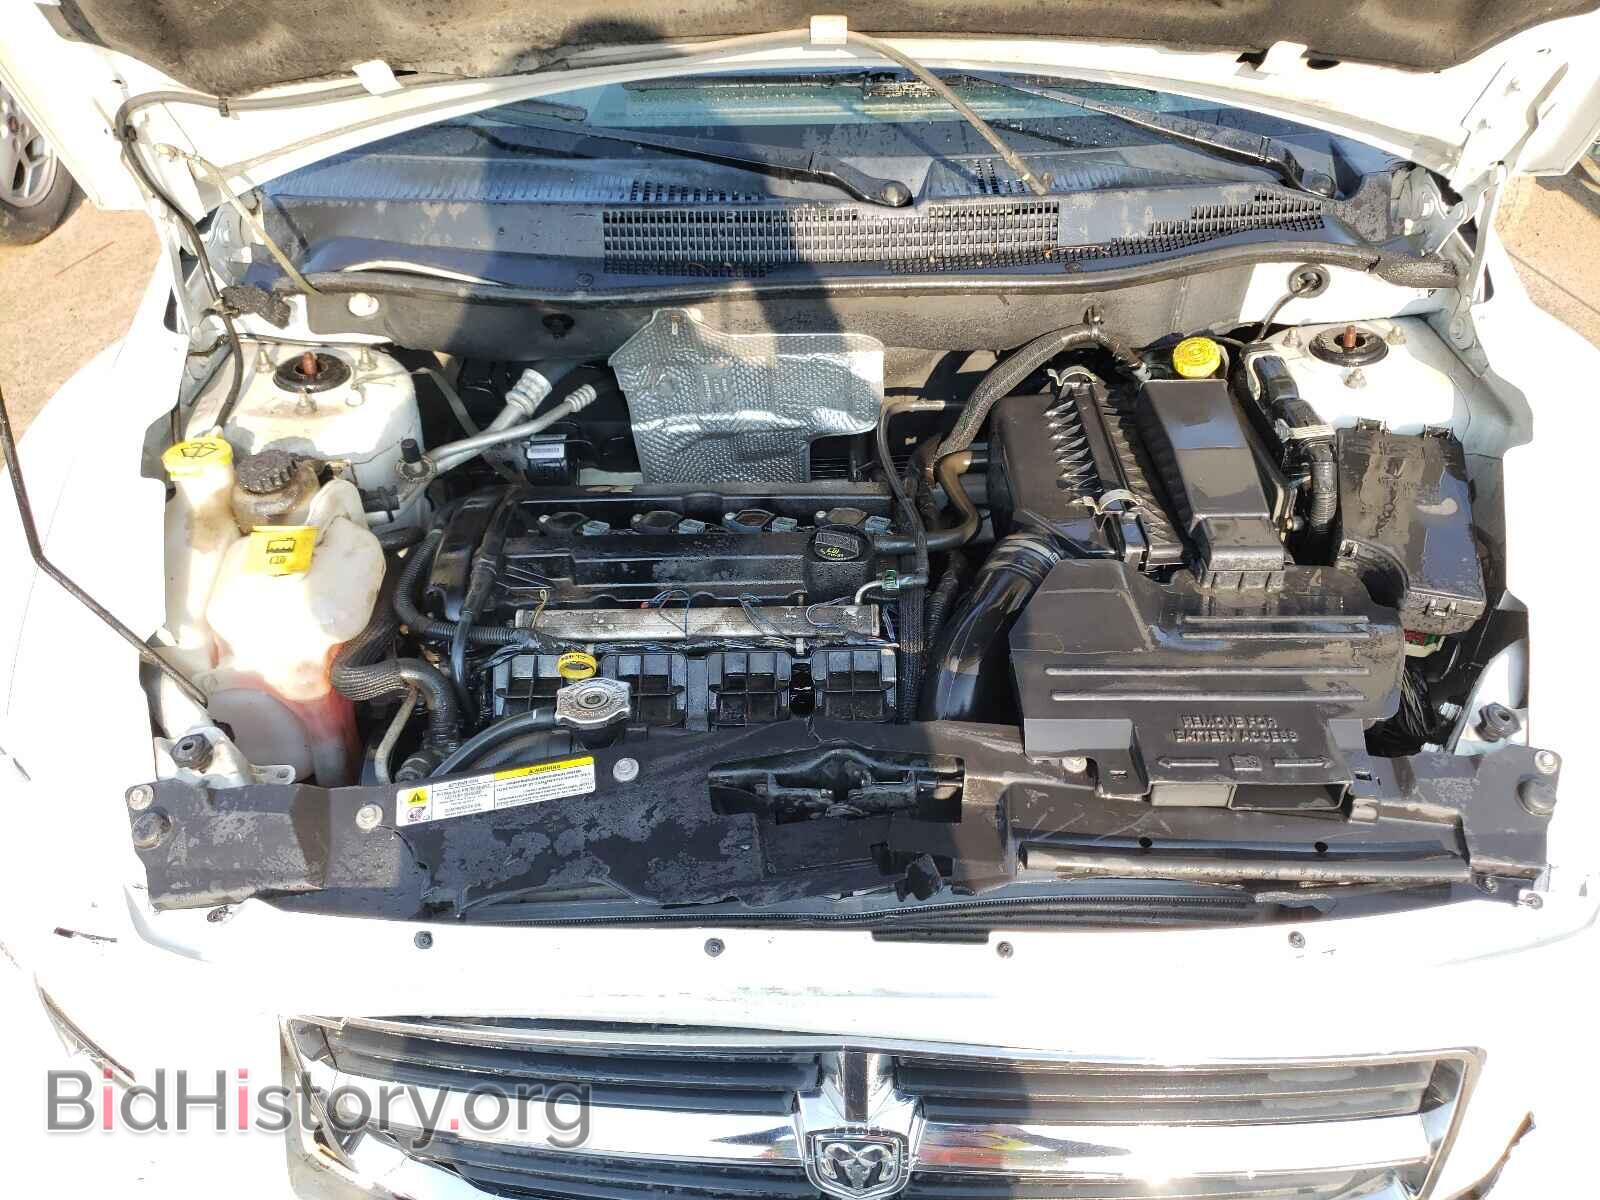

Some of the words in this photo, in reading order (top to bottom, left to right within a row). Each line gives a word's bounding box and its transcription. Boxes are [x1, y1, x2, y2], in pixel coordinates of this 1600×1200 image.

[1181, 715, 1246, 729] REMOVE
[1248, 715, 1279, 729] FOR
[1174, 729, 1236, 743] BATTERY
[1241, 730, 1299, 743] ACCESS
